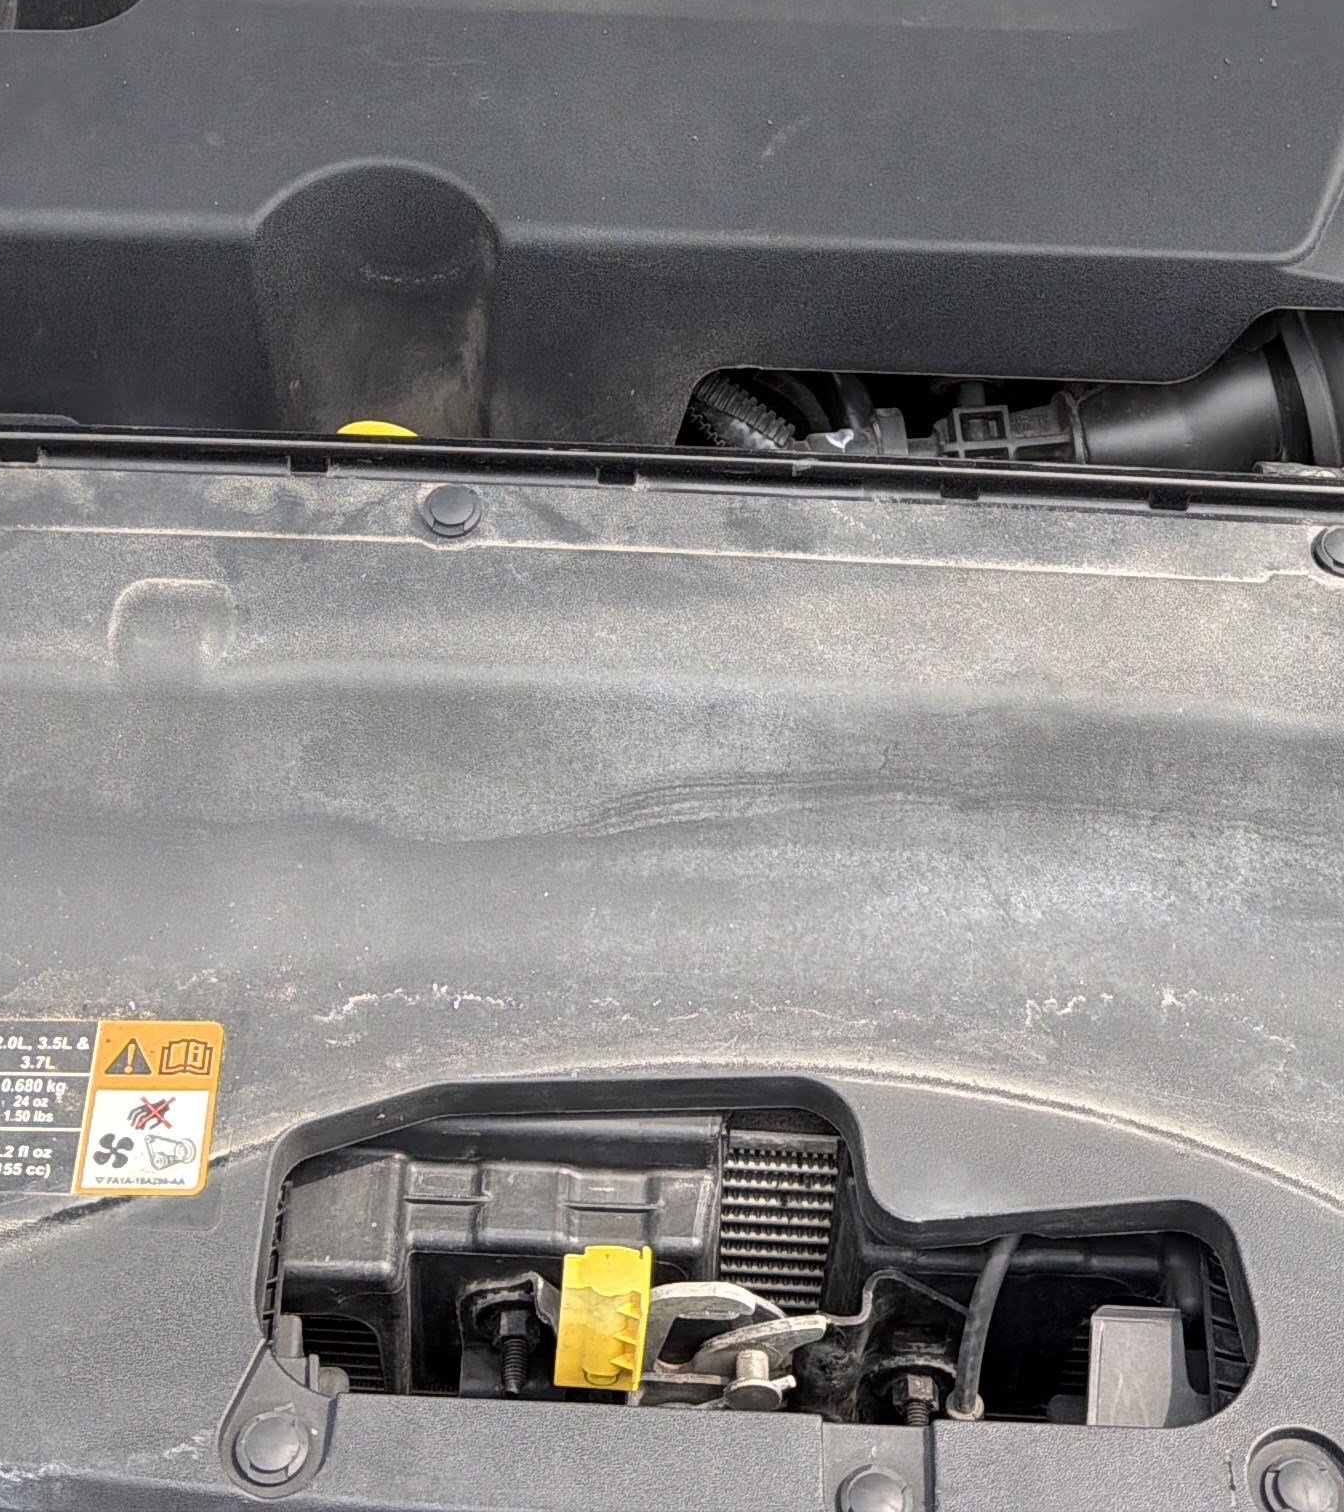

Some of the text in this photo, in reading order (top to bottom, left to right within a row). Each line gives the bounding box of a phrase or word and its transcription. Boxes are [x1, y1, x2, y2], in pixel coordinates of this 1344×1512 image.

[37, 1036, 72, 1050] 3.5L
[76, 1036, 90, 1050] &
[20, 1056, 56, 1070] 3.7L
[0, 1078, 67, 1096] 0.680 kg
[12, 1095, 49, 1108] 24 oz
[3, 1110, 54, 1123] 1.50 lbs
[17, 1145, 29, 1158] fl
[32, 1148, 53, 1159] oz
[25, 1163, 51, 1179] cc)
